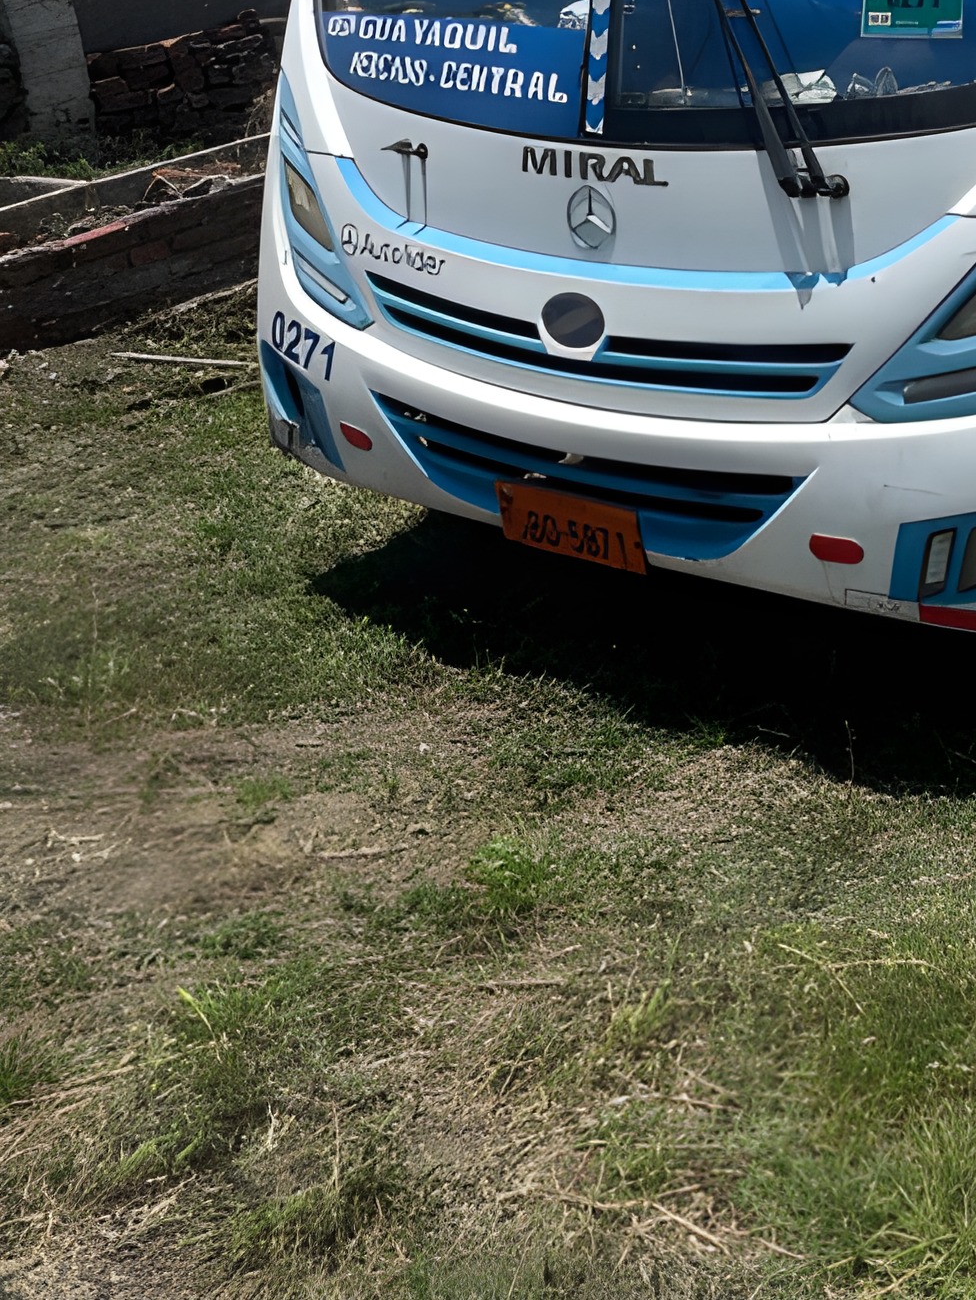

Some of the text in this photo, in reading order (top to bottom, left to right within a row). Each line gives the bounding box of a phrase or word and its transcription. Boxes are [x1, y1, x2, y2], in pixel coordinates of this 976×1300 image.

[440, 61, 568, 103] CENTRAL
[522, 146, 669, 187] MIRAL
[272, 311, 336, 382] 0271
